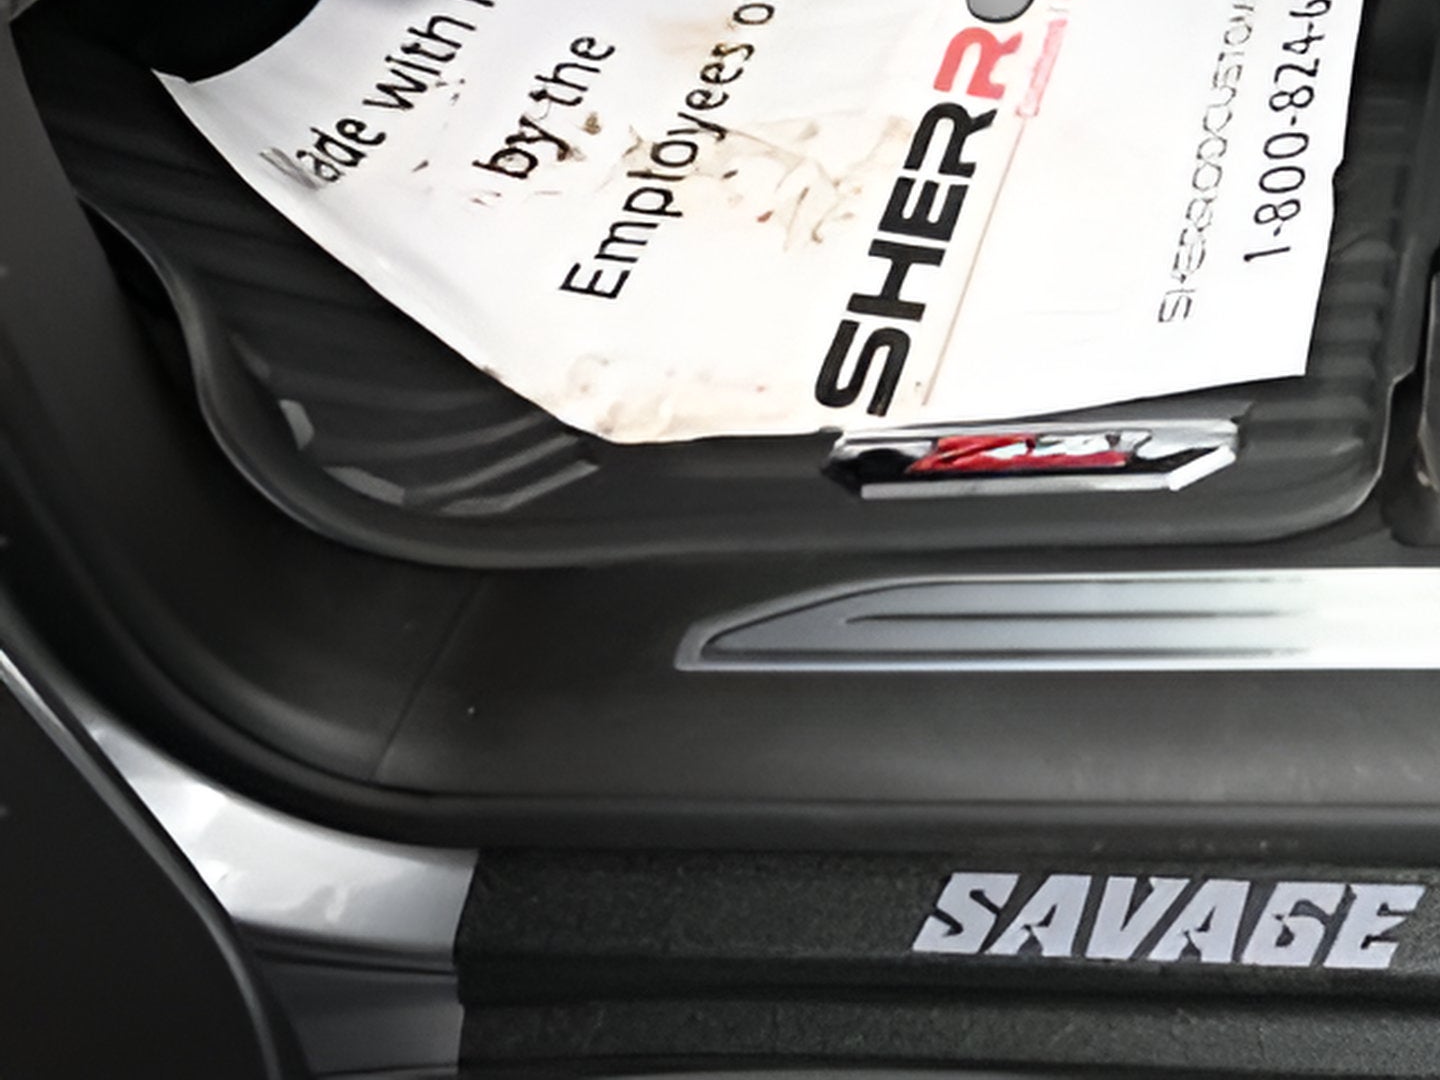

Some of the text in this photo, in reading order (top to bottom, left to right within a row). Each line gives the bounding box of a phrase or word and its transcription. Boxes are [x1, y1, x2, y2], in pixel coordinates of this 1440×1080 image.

[362, 13, 477, 112] with
[472, 32, 616, 180] by the
[559, 39, 755, 300] Employees
[911, 872, 1427, 969] SAVAGE
